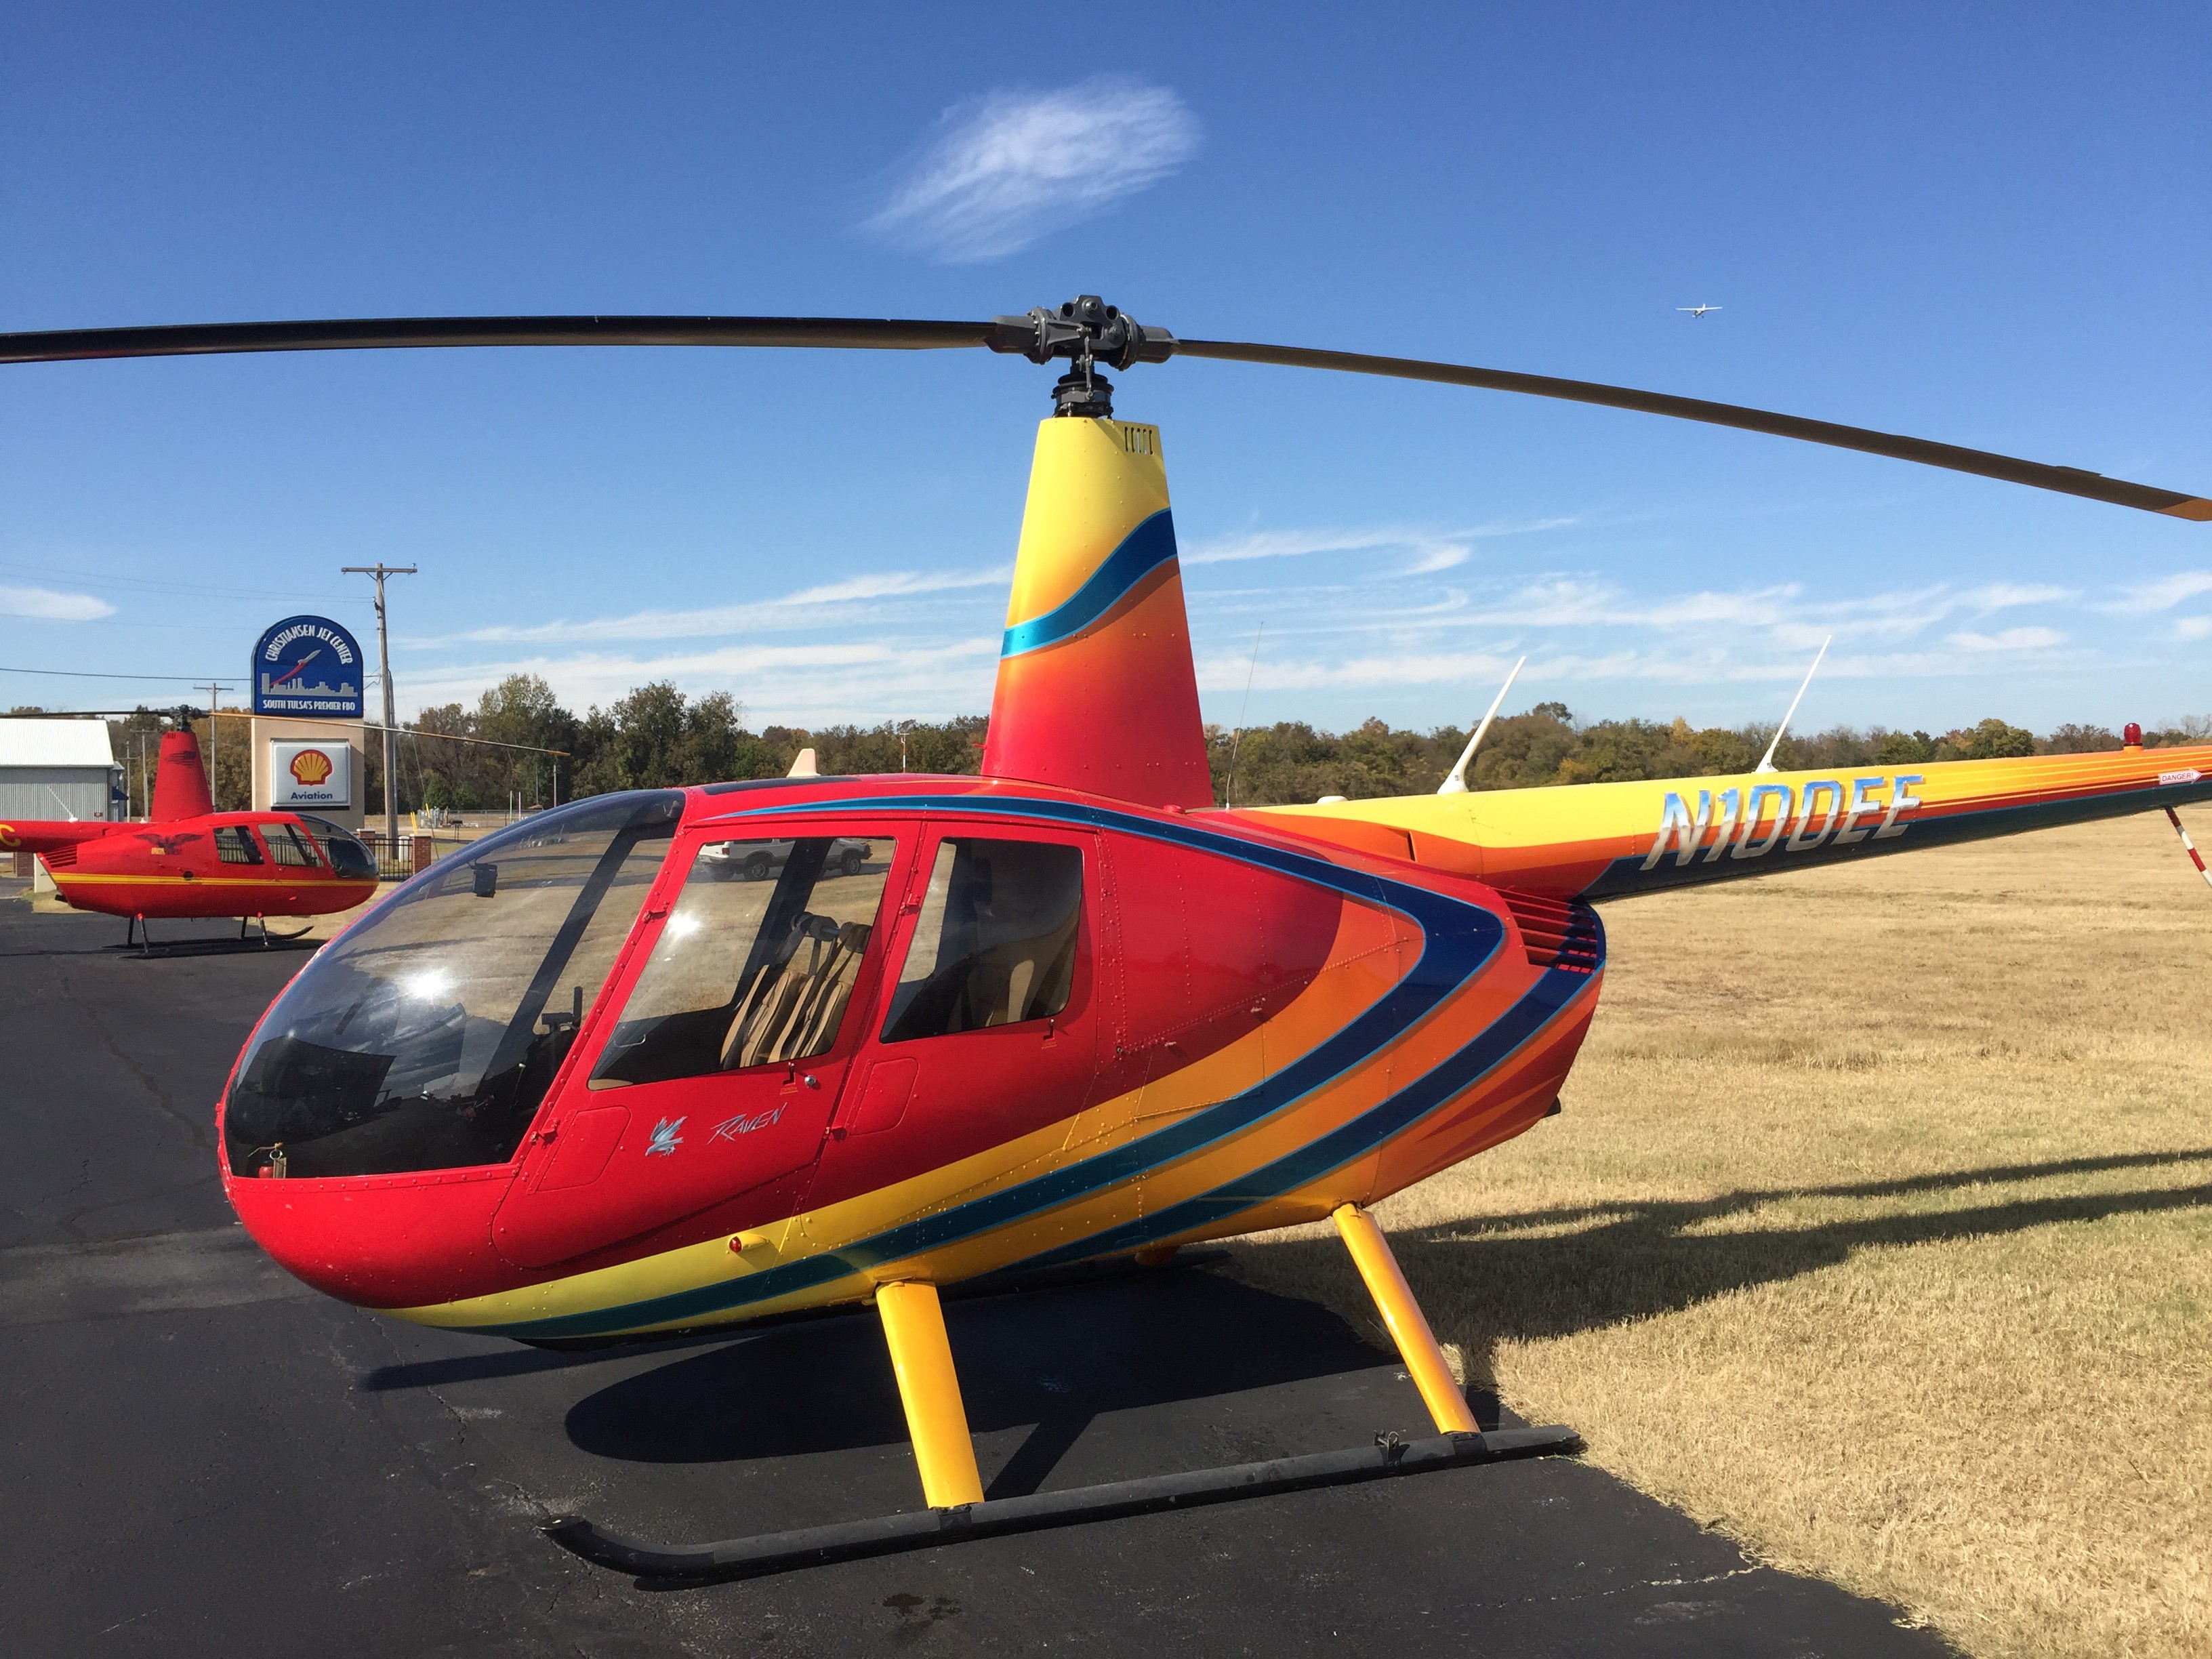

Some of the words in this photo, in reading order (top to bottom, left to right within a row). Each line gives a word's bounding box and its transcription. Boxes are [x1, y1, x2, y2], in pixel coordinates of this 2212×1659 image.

[265, 624, 316, 661] CHRISTIANSEN
[316, 627, 334, 641] JET
[329, 636, 353, 665] CENTER
[263, 699, 286, 709] SOUTH
[287, 700, 312, 710] TULSA'S
[314, 701, 341, 710] PREMIER
[342, 702, 355, 711] FBO
[2162, 772, 2194, 782] DANGER!
[290, 792, 333, 800] Aviation
[1639, 775, 1924, 871] N100EE
